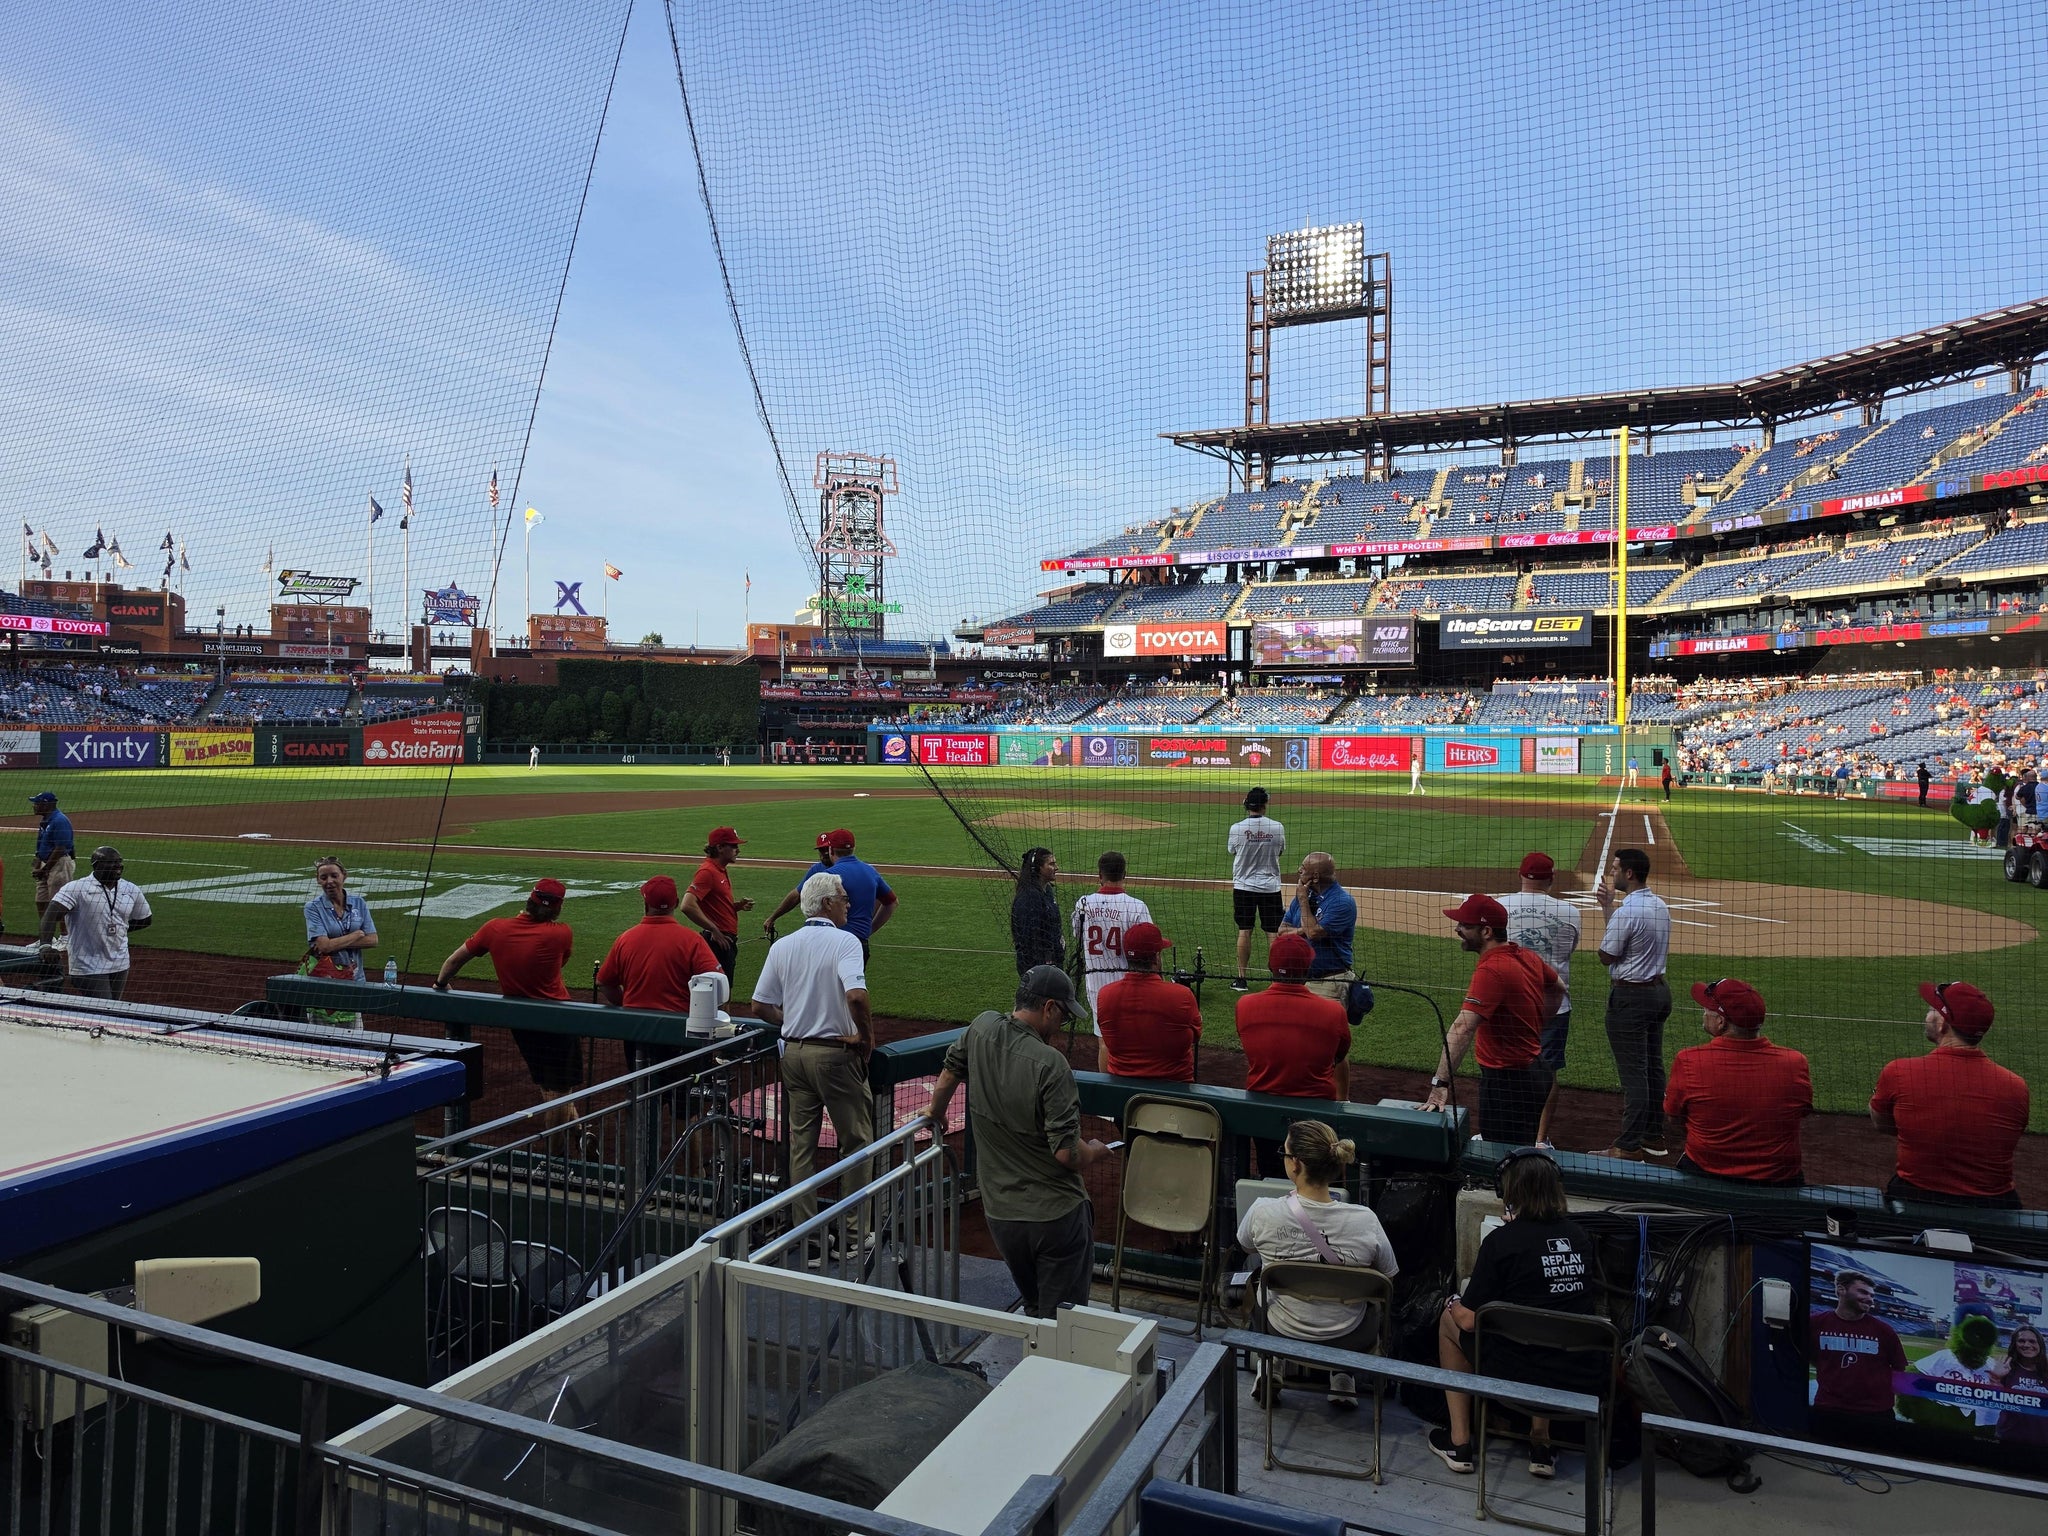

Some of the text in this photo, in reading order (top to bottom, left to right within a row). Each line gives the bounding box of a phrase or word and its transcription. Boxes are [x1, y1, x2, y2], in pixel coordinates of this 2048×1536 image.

[1841, 491, 1903, 511] JIM BEAM
[1335, 540, 1442, 554] WHEY BETTER PROTEIN
[1122, 556, 1167, 566] Deals roll in
[1207, 549, 1293, 561] LISCIO'S BAKERY
[1064, 560, 1091, 569] Phillies
[285, 573, 352, 587] Fitzpatrick
[111, 606, 160, 616] GIANT
[424, 599, 481, 609] ALL STAR GAME
[808, 597, 902, 613] Citizens Bank
[56, 621, 103, 634] TOYOTA
[840, 614, 871, 628] Park
[1446, 618, 1579, 634] theScore BET
[986, 635, 998, 643] HIT
[999, 631, 1015, 641] THIS
[1015, 628, 1034, 637] SIGN
[1141, 630, 1218, 648] TOYOTA
[1460, 637, 1483, 645] Gambling
[1816, 623, 1922, 646] POSTGAME
[110, 647, 139, 655] Fanatics
[1372, 646, 1408, 654] TECHNOLOGY
[1694, 638, 1748, 652] JIM BEAM
[440, 719, 462, 727] neighbor
[64, 734, 150, 763] xfinity
[175, 739, 199, 748] WHO BUT
[284, 743, 349, 757] GIANT
[945, 738, 985, 752] Temple
[1150, 738, 1227, 752] POSTGAME
[1239, 742, 1272, 757] JIM BEAM
[621, 754, 636, 764] 401
[945, 751, 982, 762] Health
[1150, 751, 1187, 759] CONCERT
[1192, 757, 1208, 765] FLO
[1450, 748, 1492, 763] HERR'S
[1244, 829, 1274, 840] Phillies
[1086, 907, 1121, 921] SURFSIDE
[1087, 925, 1121, 956] 24
[1541, 1253, 1582, 1267] REPLAY
[1544, 1265, 1585, 1278] REVIEW
[1550, 1282, 1584, 1293] zoom
[1820, 1331, 1879, 1341] PHILADELPHIA
[1935, 1382, 1973, 1397] GREG
[1974, 1388, 2041, 1408] OPLINGER
[1955, 1396, 2021, 1412] GROUP LEADERS
